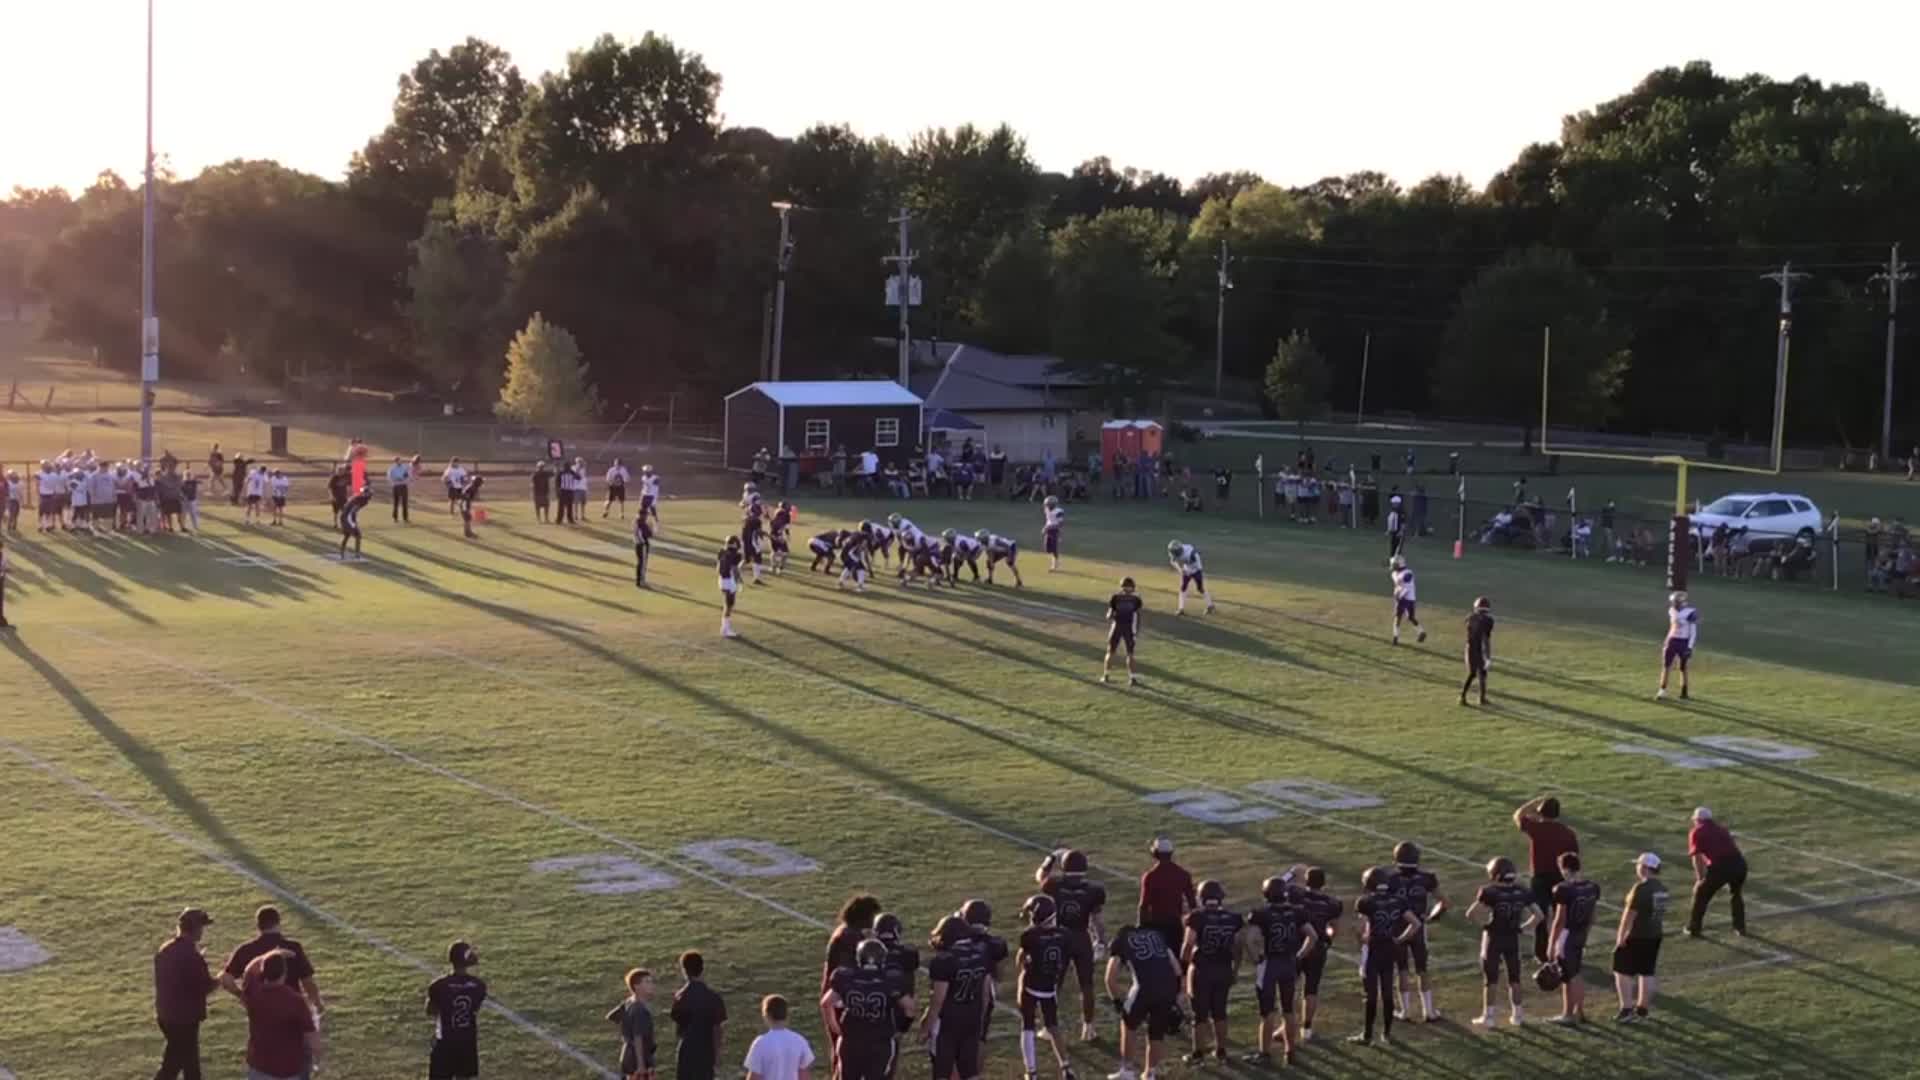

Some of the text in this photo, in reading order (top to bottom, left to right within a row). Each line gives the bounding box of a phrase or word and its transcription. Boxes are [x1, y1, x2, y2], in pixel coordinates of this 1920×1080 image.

[1140, 778, 1387, 824] 20
[528, 836, 823, 894] 30
[451, 994, 473, 1029] 2
[846, 990, 888, 1020] 63
